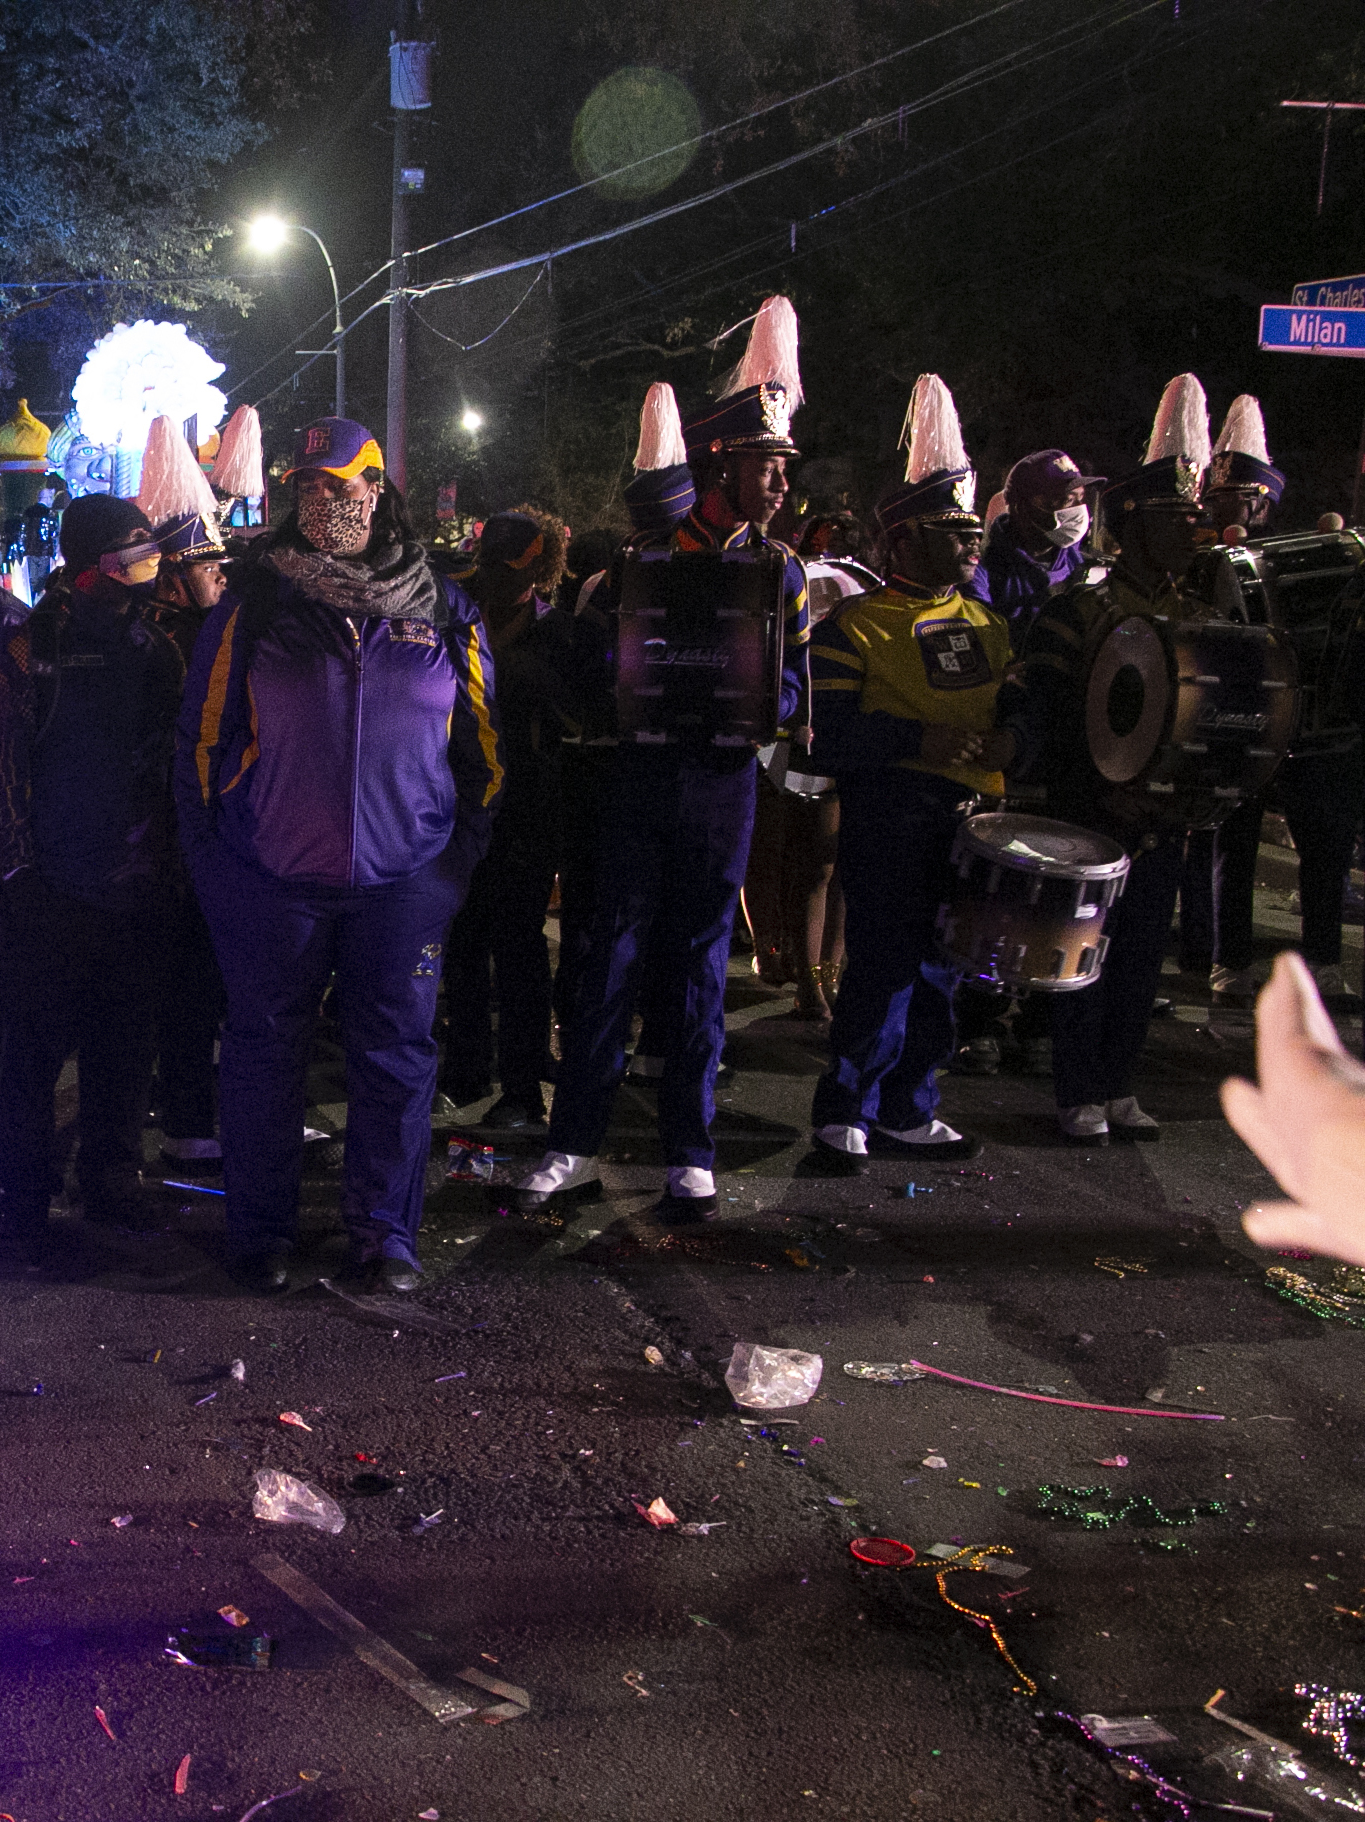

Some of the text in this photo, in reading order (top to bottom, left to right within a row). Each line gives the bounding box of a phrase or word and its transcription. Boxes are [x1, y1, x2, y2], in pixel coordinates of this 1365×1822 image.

[1295, 283, 1365, 308] St Charles
[1289, 313, 1347, 344] Milan
[305, 427, 331, 455] E
[643, 638, 732, 669] Dynasty
[1197, 702, 1270, 732] Dynasty
